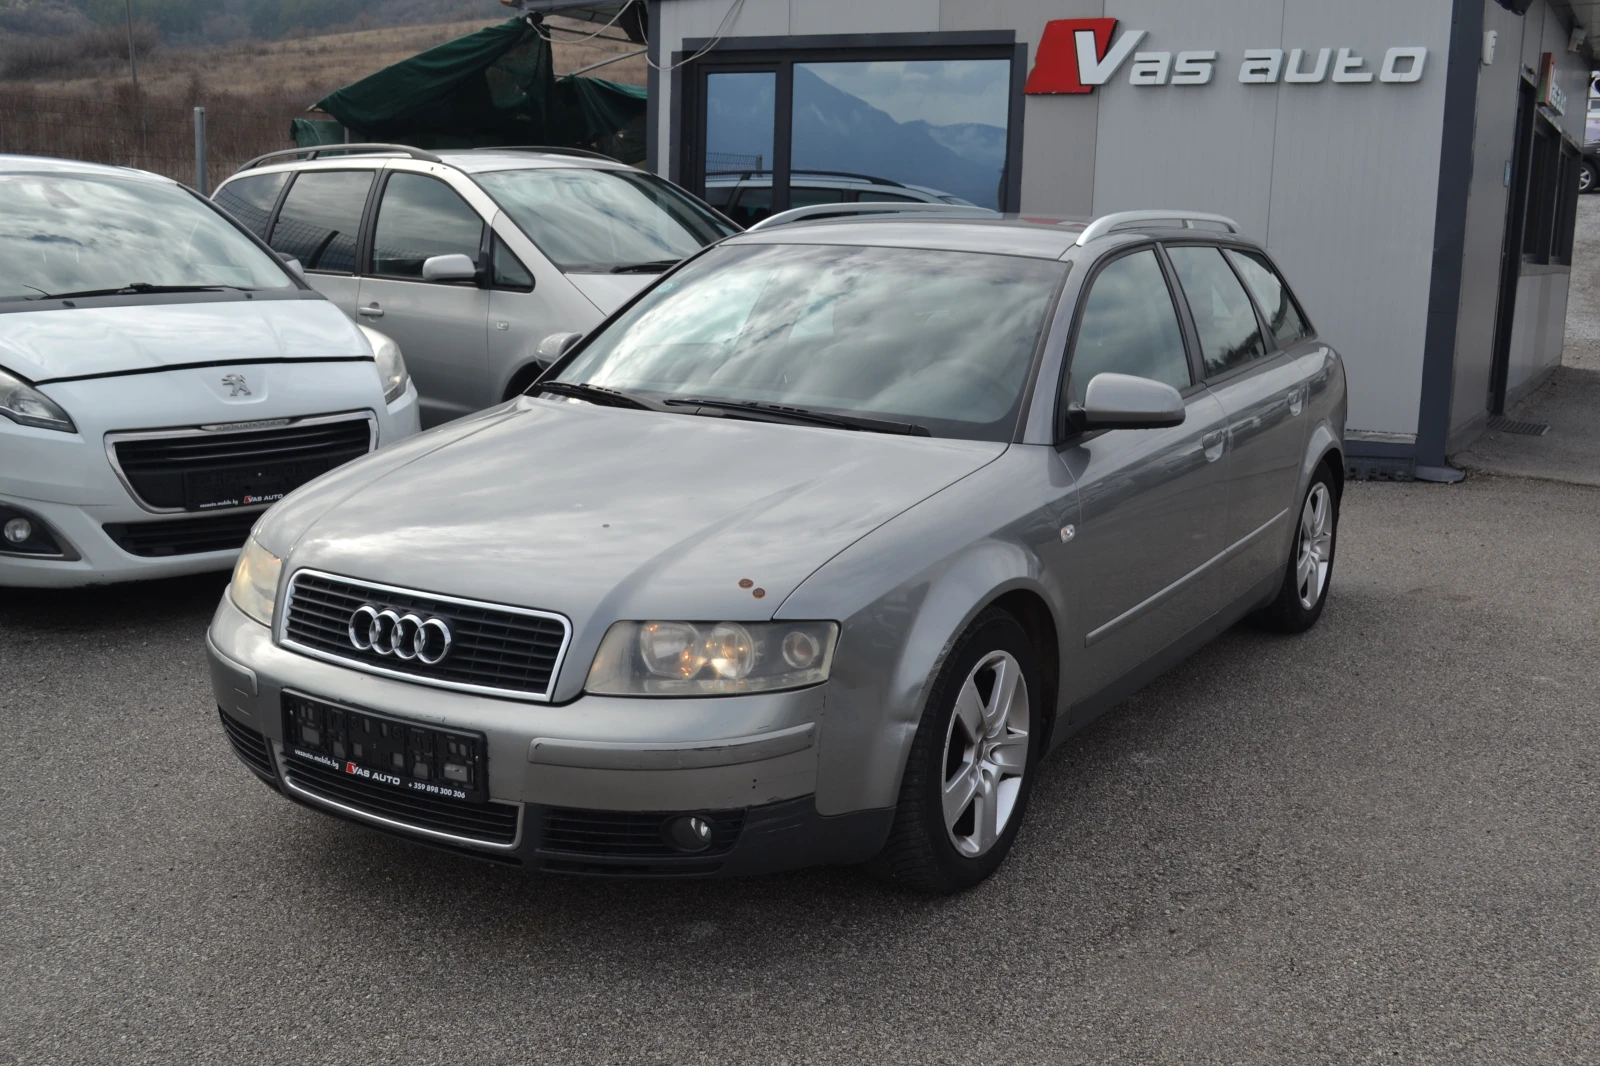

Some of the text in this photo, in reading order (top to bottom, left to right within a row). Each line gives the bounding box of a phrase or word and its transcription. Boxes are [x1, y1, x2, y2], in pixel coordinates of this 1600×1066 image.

[1073, 29, 1428, 86] Vas auto
[263, 493, 284, 501] AUTO
[294, 749, 340, 770] vasauto.mobile.bg
[351, 765, 401, 786] VAS AUTO
[413, 781, 426, 790] 359
[426, 784, 439, 794] 898
[439, 787, 452, 796] 300
[452, 790, 466, 799] 306
